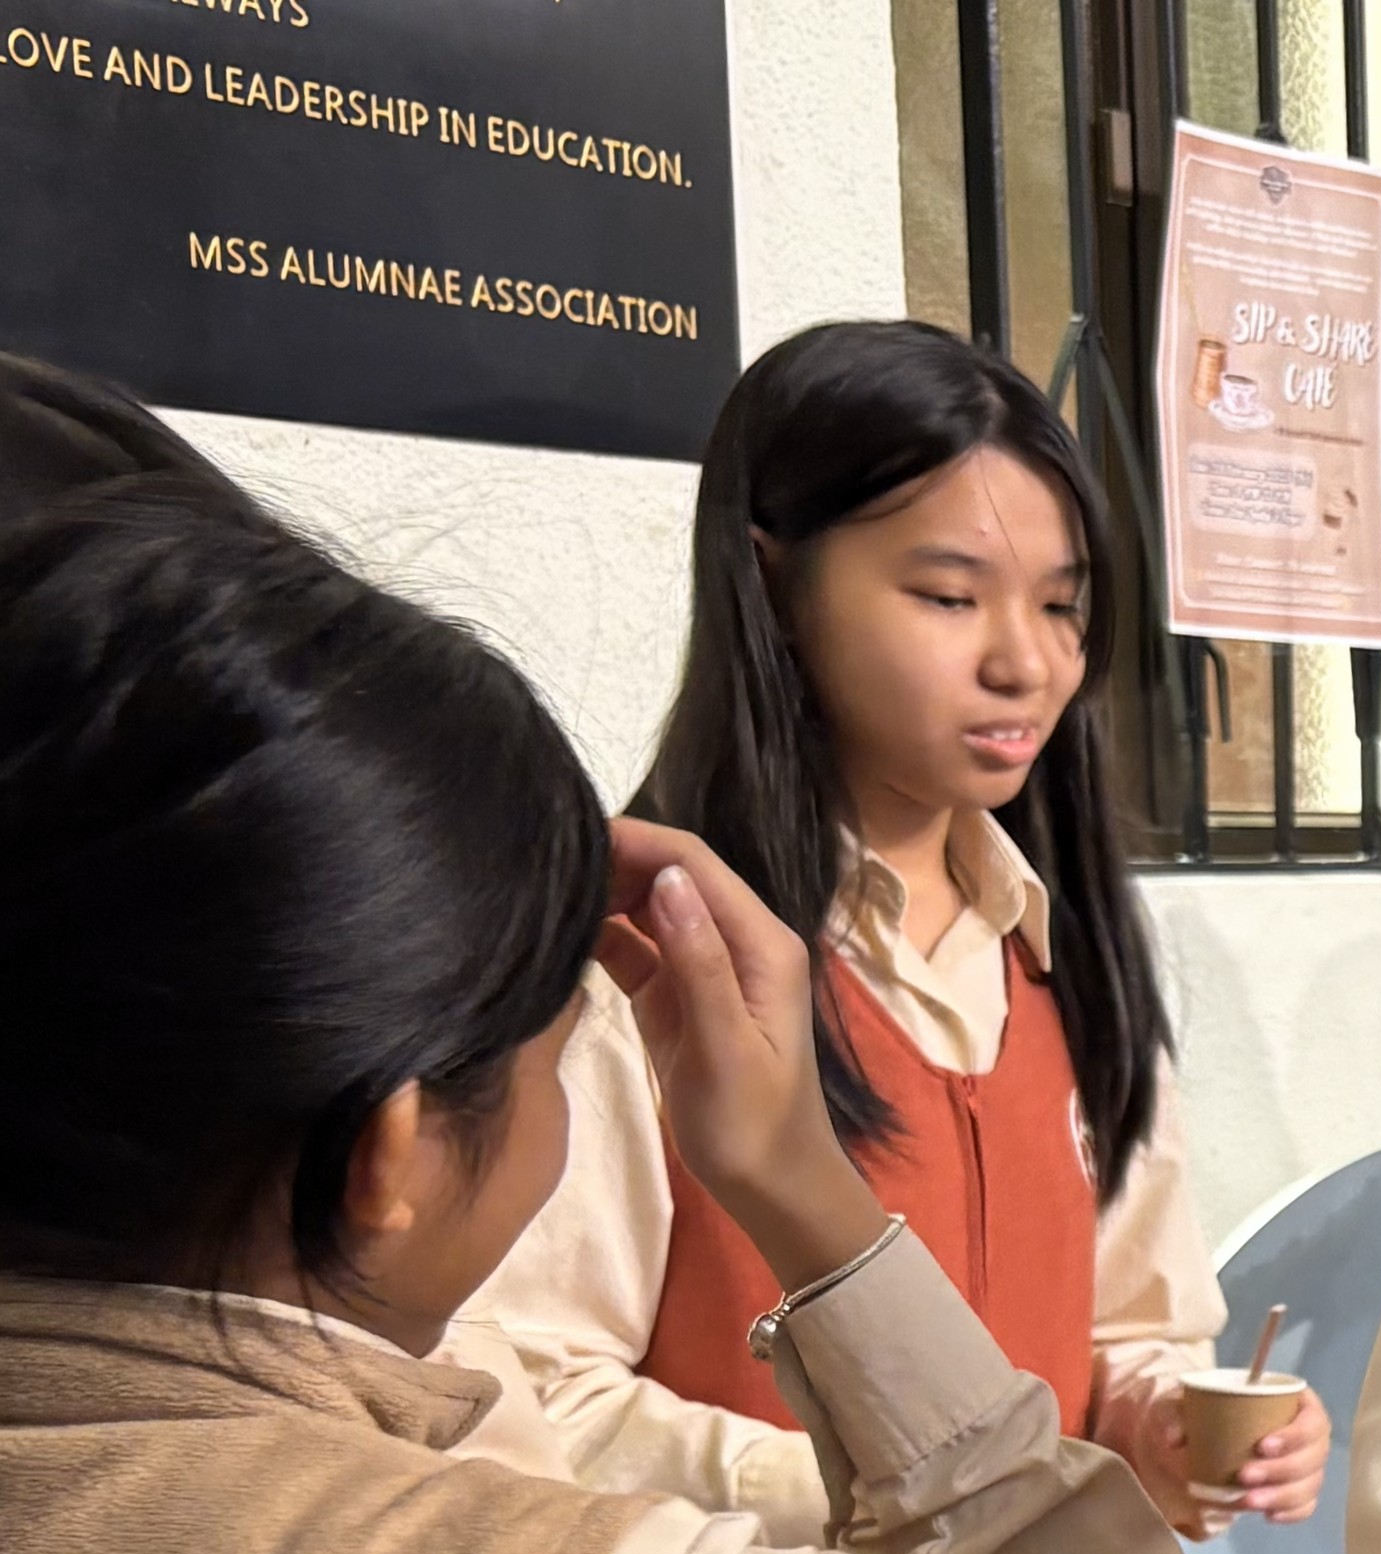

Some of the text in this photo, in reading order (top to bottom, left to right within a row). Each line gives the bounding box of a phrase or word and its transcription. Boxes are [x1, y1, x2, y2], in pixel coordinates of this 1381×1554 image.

[104, 46, 192, 94] AND
[205, 63, 429, 138] LEADERSHIP
[438, 107, 477, 148] IN
[487, 117, 693, 188] EDUCATION.
[189, 233, 698, 340] MSS ALUMNAE ASSOCIATION
[1231, 300, 1378, 367] SIP & SHARE
